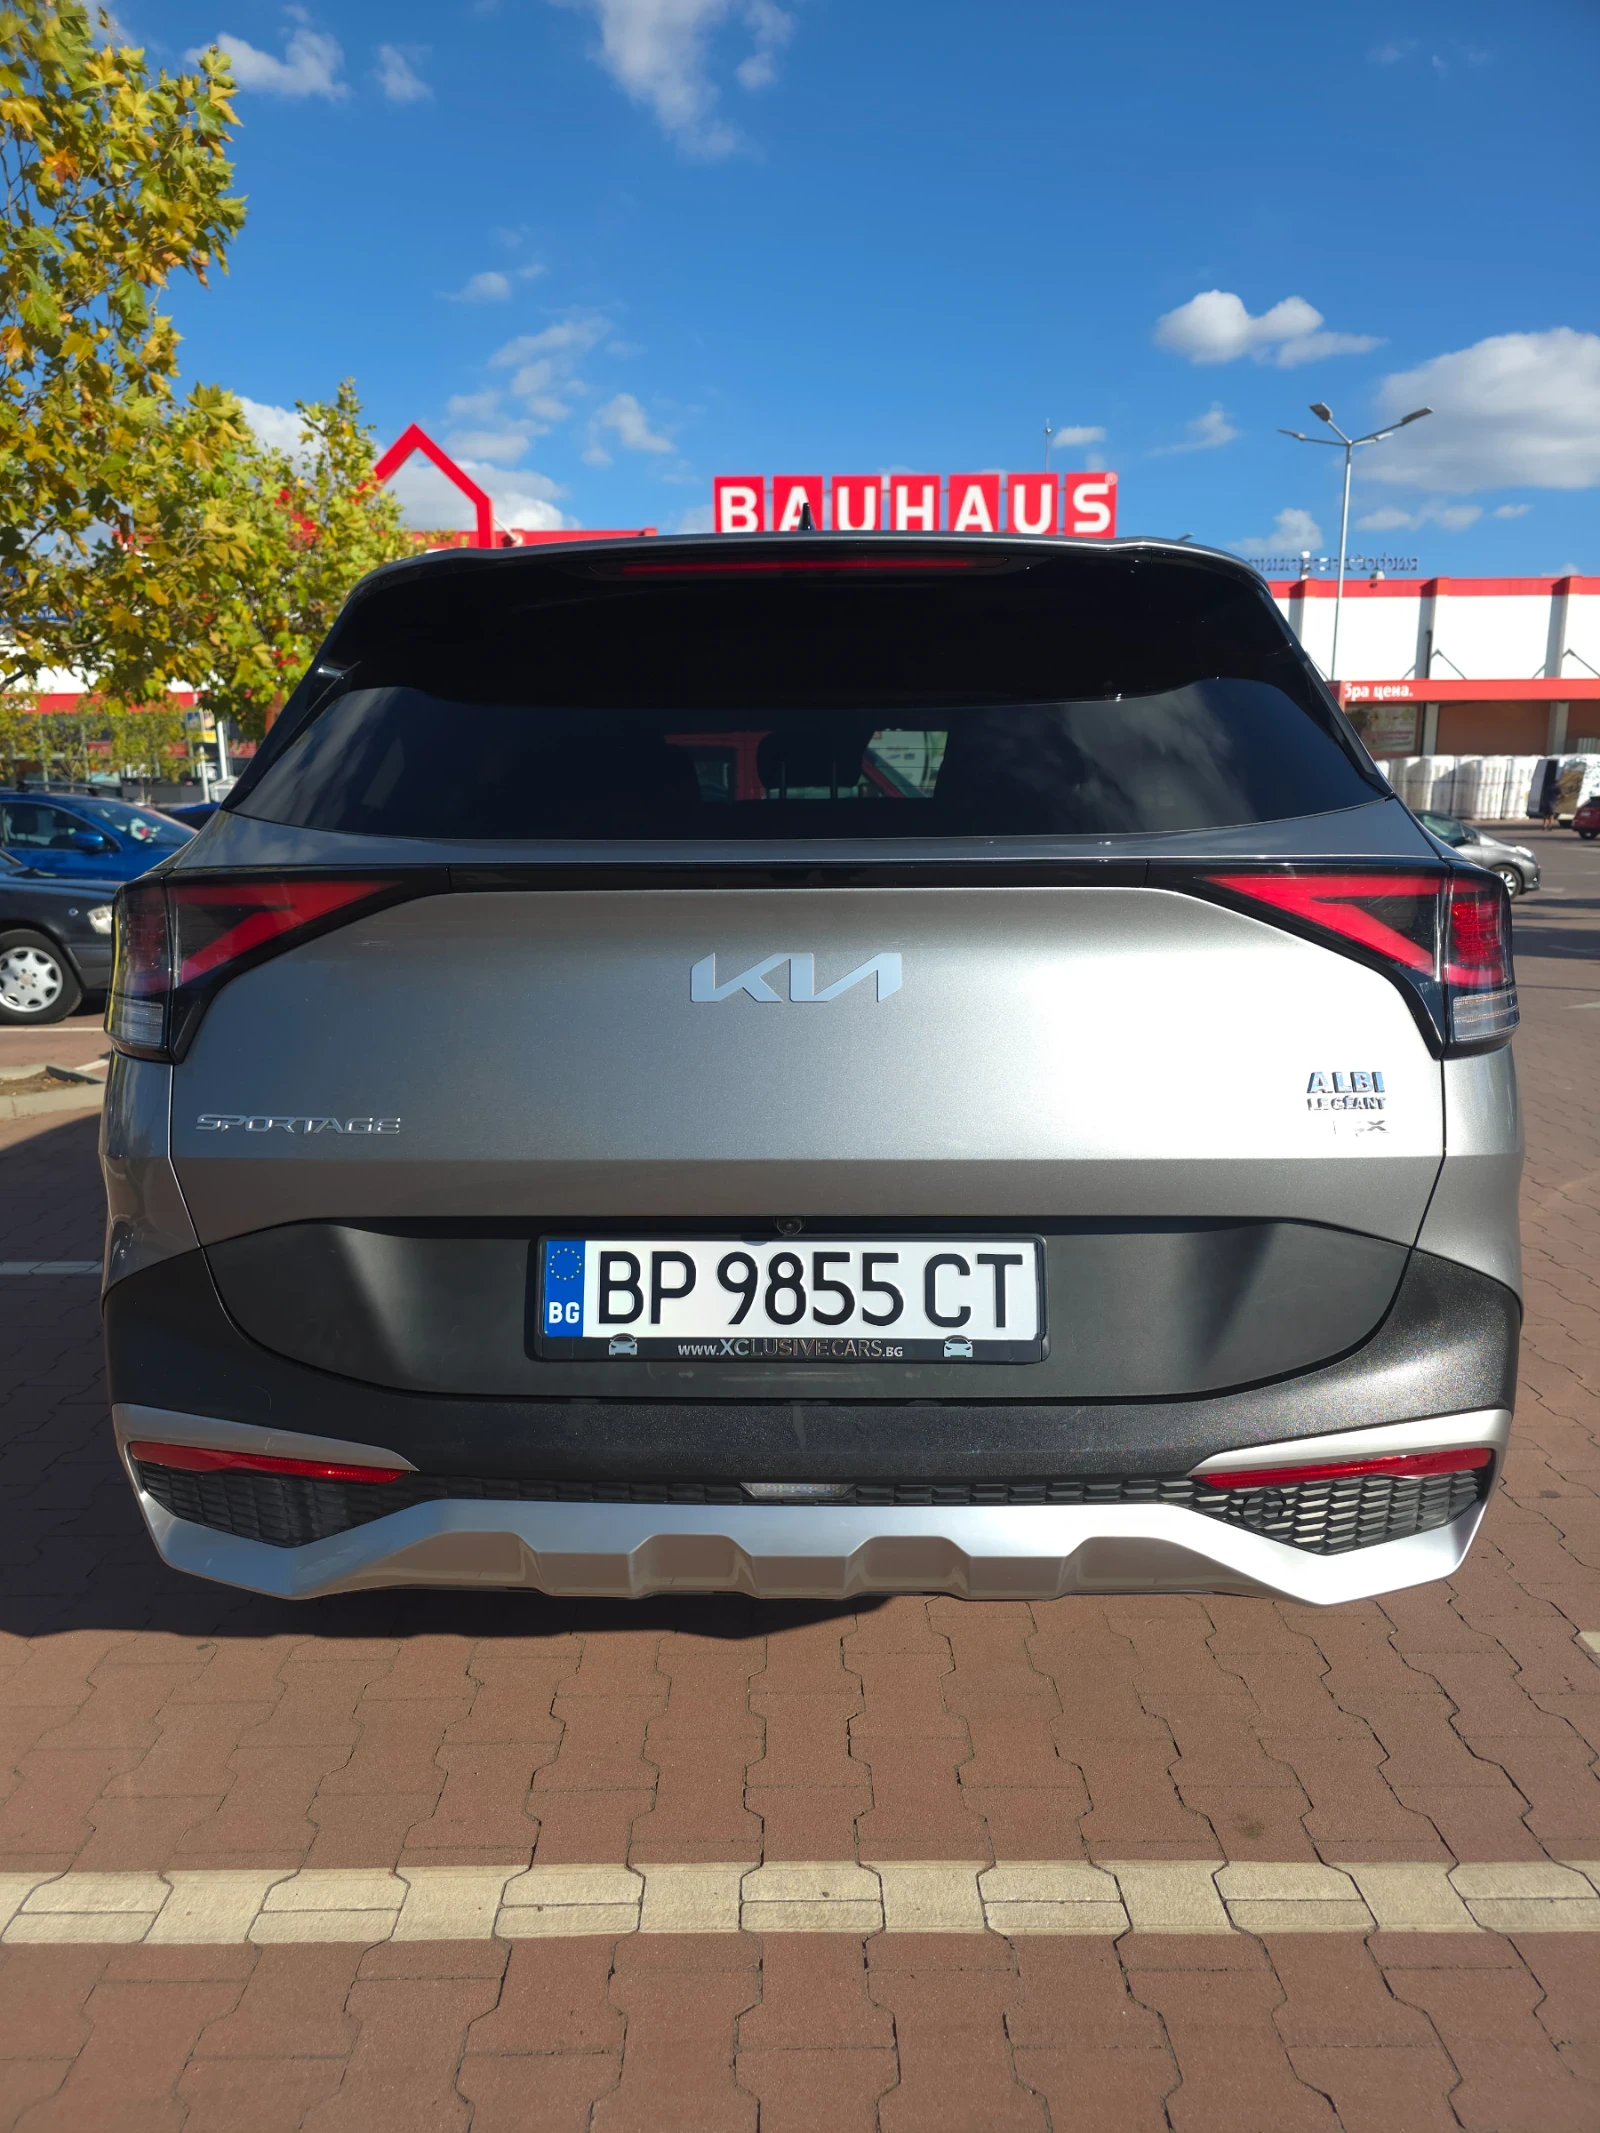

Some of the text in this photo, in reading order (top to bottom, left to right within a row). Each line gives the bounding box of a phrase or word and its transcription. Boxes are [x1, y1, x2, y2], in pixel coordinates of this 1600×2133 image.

[720, 481, 1112, 534] BAUHAUS
[1373, 684, 1414, 700] цена.
[690, 952, 903, 1003] KIA
[1306, 1071, 1386, 1093] ALBI
[195, 1113, 402, 1135] SPORTAGE
[598, 1250, 1024, 1328] BP 9855 CT
[548, 1301, 581, 1325] BG
